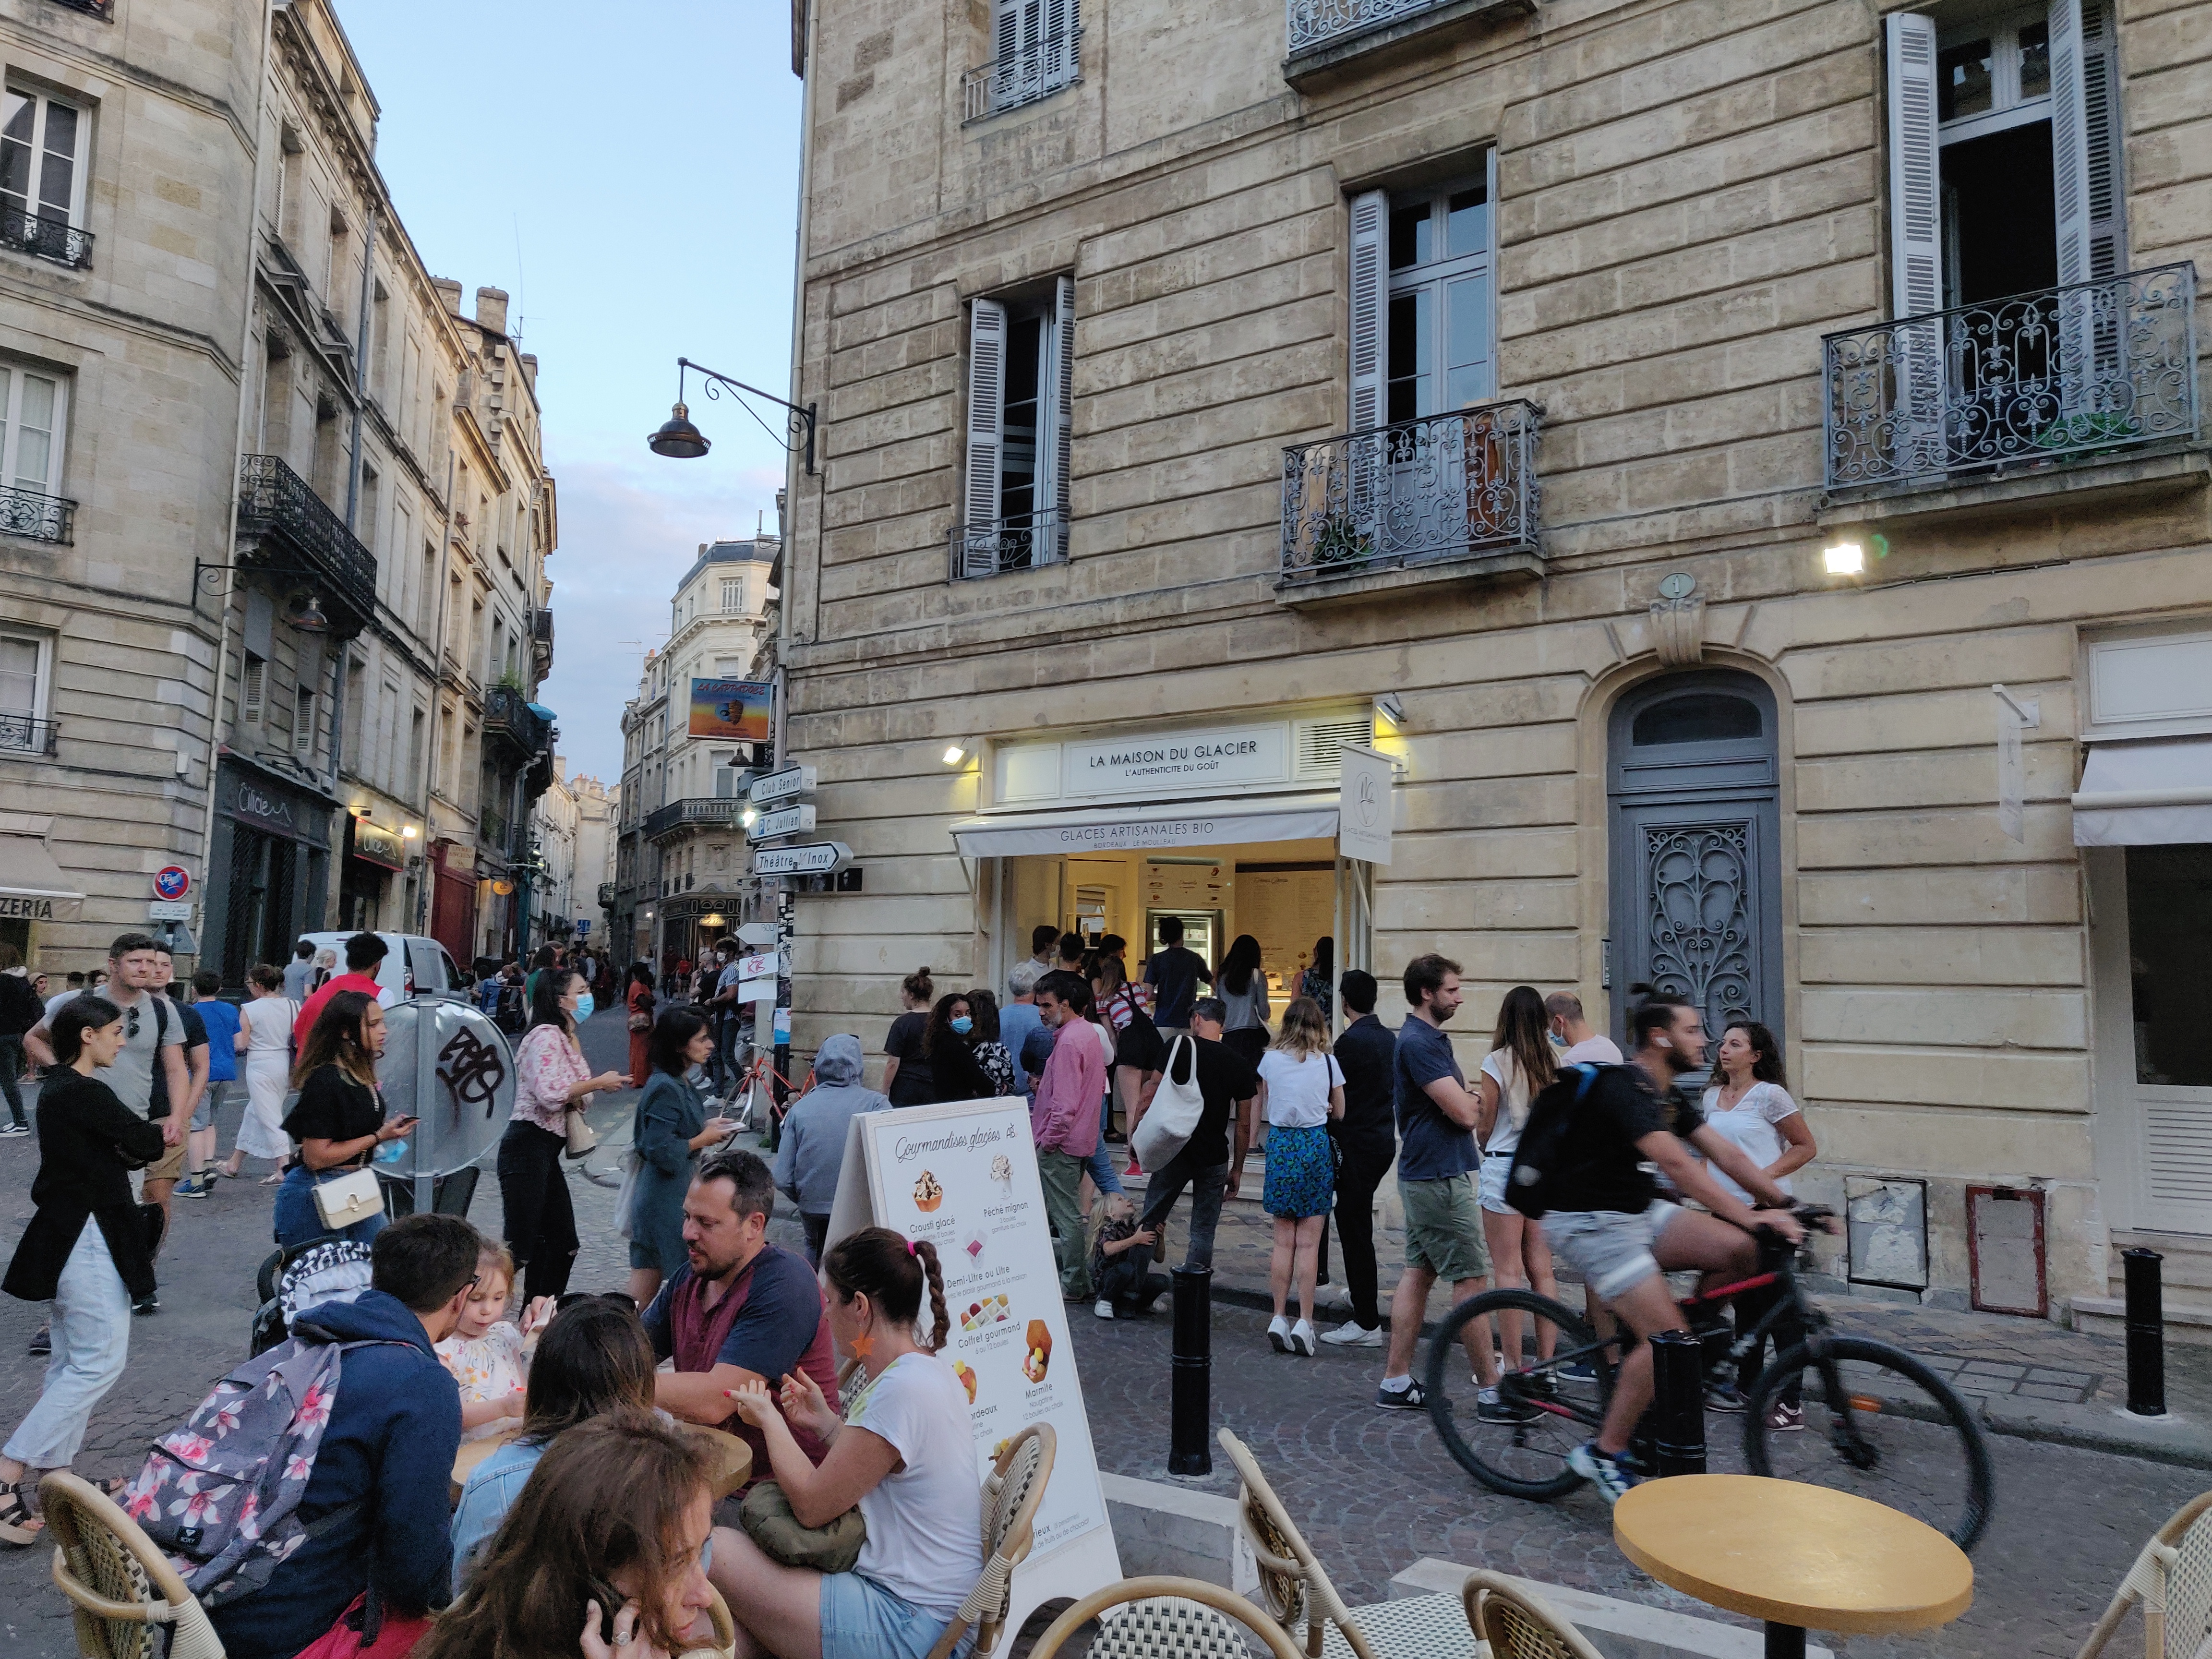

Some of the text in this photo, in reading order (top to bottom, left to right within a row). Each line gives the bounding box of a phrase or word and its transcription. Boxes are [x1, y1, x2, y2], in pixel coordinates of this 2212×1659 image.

[1672, 576, 1680, 593] 1
[697, 683, 710, 691] LA
[1090, 741, 1257, 767] LA MAISON DU GLACIER
[1125, 760, 1219, 776] L'AUTHENTICITE DU GOÛT
[761, 775, 799, 795] Club Sénior
[776, 814, 798, 830] Jullian
[1060, 822, 1214, 841] GLACES ARTISANALES BIO
[759, 855, 793, 869] Théâtre
[895, 1130, 967, 1163] Gourmandises
[967, 1127, 1001, 1152] glacées
[984, 1202, 1029, 1218] Péché mignon
[910, 1214, 955, 1233] Crousti glacé
[947, 1272, 983, 1288] Demi-Litre
[996, 1266, 1010, 1275] Litre
[976, 1279, 1001, 1293] gourmand
[1011, 1273, 1027, 1282] maison
[958, 1322, 1021, 1348] Coffret gourmand
[993, 1338, 1009, 1349] boules
[1025, 1383, 1053, 1400] Marmite
[1029, 1395, 1053, 1408] Nougatine
[1029, 1408, 1044, 1419] boules
[1051, 1400, 1064, 1410] choix
[971, 1404, 998, 1420] rdeaux
[980, 1428, 994, 1438] choix
[1033, 1525, 1051, 1539] rieux
